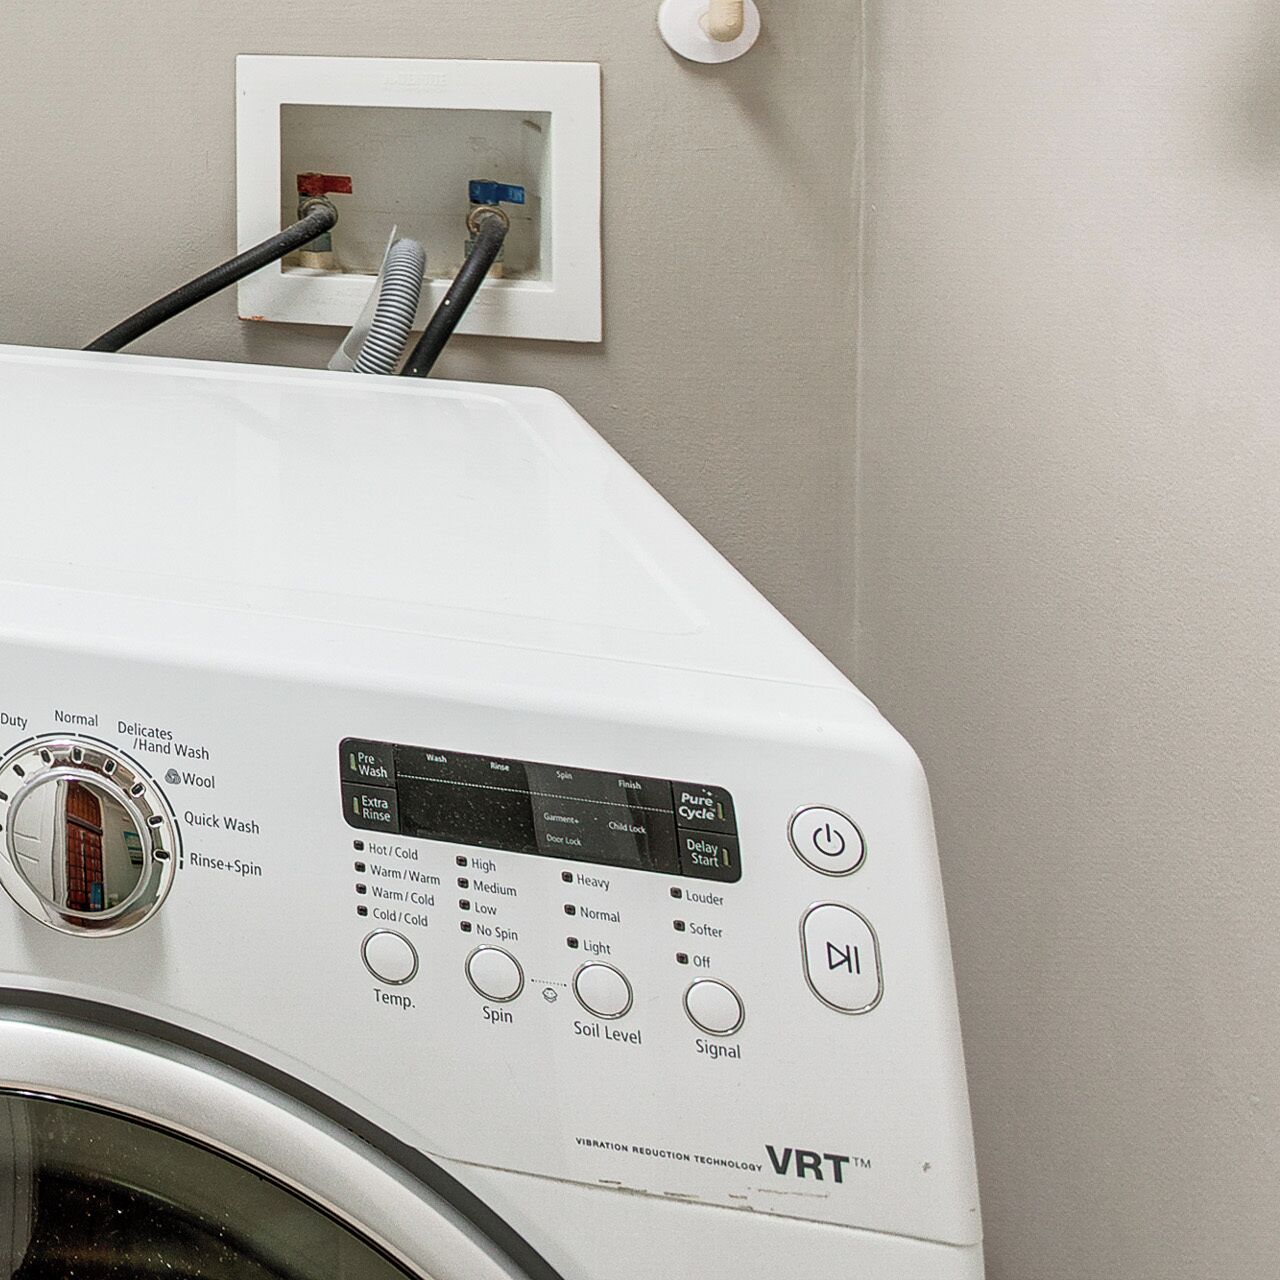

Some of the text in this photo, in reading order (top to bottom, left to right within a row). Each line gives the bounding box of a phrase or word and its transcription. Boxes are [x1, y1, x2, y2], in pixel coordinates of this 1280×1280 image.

[0, 712, 28, 731] Duty
[54, 709, 99, 727] Normal
[118, 721, 173, 741] Delicates
[174, 743, 210, 761] Wash
[357, 752, 375, 765] Pre
[425, 753, 448, 764] Wash
[358, 764, 388, 779] Wash
[490, 761, 510, 772] Rinse
[182, 772, 216, 789] Wool
[555, 770, 573, 781] Spin
[618, 779, 642, 790] Finish
[362, 795, 389, 810] Extra
[681, 792, 713, 807] Pure
[362, 808, 391, 822] Rinse
[678, 806, 716, 821] Cycle
[184, 810, 260, 835] Quick Wash
[608, 821, 647, 835] Child Lock
[546, 833, 582, 846] Door Lock
[686, 839, 718, 856] Delay
[471, 858, 497, 873] High
[692, 853, 720, 868] Start
[473, 880, 517, 897] Medium
[576, 874, 610, 892] Heavy
[686, 889, 725, 906] Louder
[474, 902, 497, 916] Low
[580, 906, 621, 923] Normal
[476, 924, 519, 941] No Spin
[689, 922, 723, 938] Softer
[583, 939, 612, 956] Light
[693, 955, 711, 969] Off
[373, 988, 416, 1010] Temp.
[482, 1004, 514, 1024] Spin
[574, 1021, 642, 1045] Soil Level
[695, 1038, 741, 1060] Signal
[575, 1137, 629, 1152] VIBRATION
[632, 1146, 691, 1162] REDUCTION
[694, 1155, 763, 1172] TECHNOLOGY
